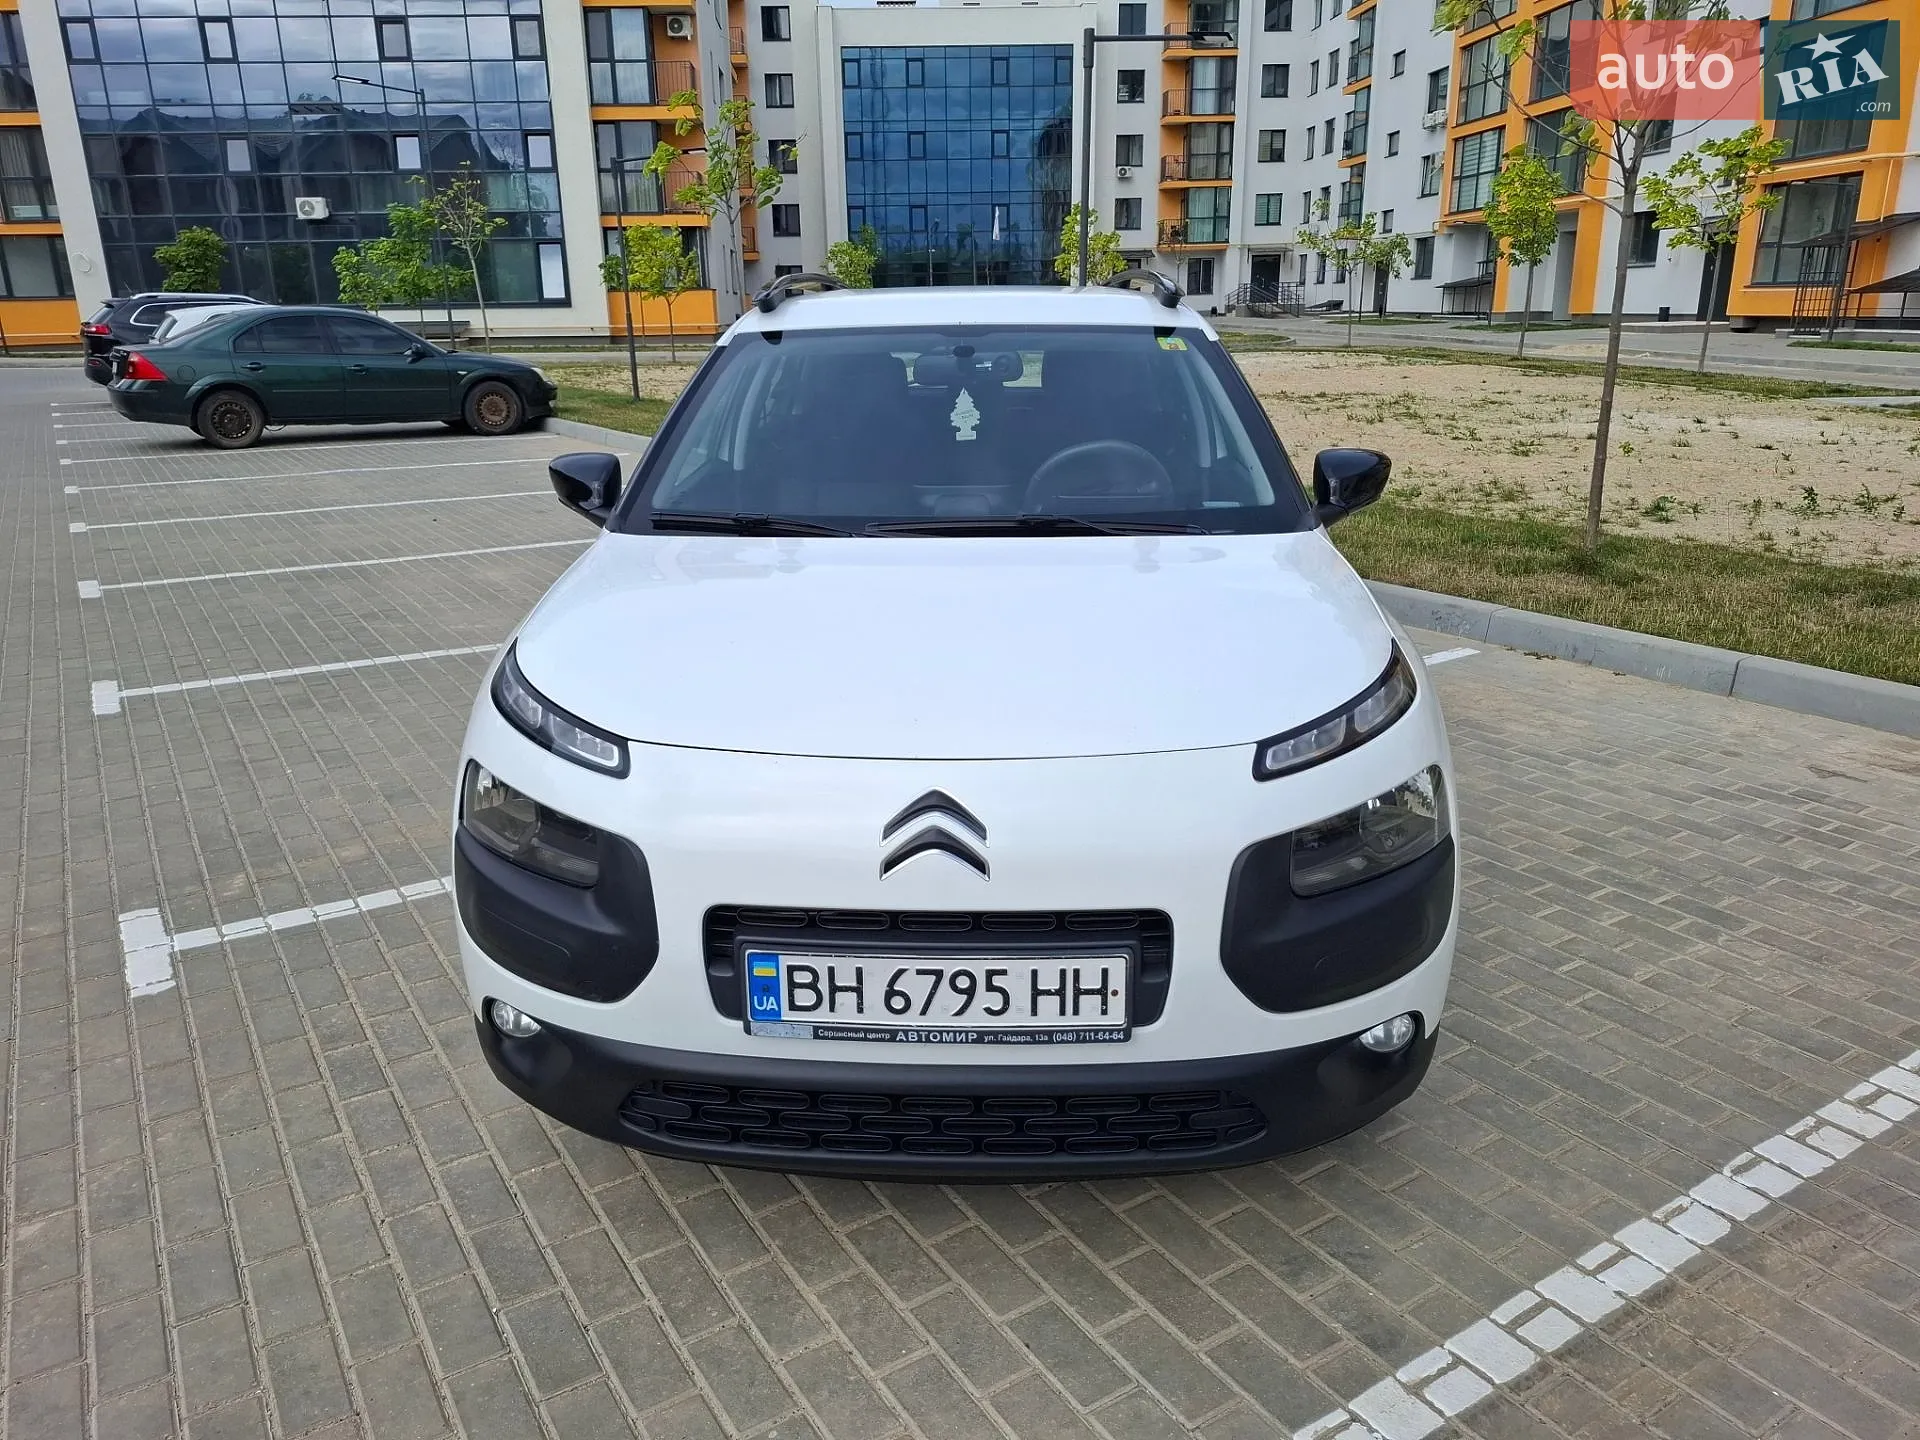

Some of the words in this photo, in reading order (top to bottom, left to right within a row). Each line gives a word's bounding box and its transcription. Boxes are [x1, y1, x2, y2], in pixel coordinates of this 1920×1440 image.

[786, 964, 864, 1014] BH
[884, 968, 1011, 1016] 6795
[1030, 967, 1109, 1016] HH
[754, 996, 779, 1011] UA
[866, 1032, 891, 1040] центр
[896, 1030, 978, 1043] АВТОМИР
[983, 1034, 997, 1043] ул.
[1053, 1031, 1077, 1043] (048)
